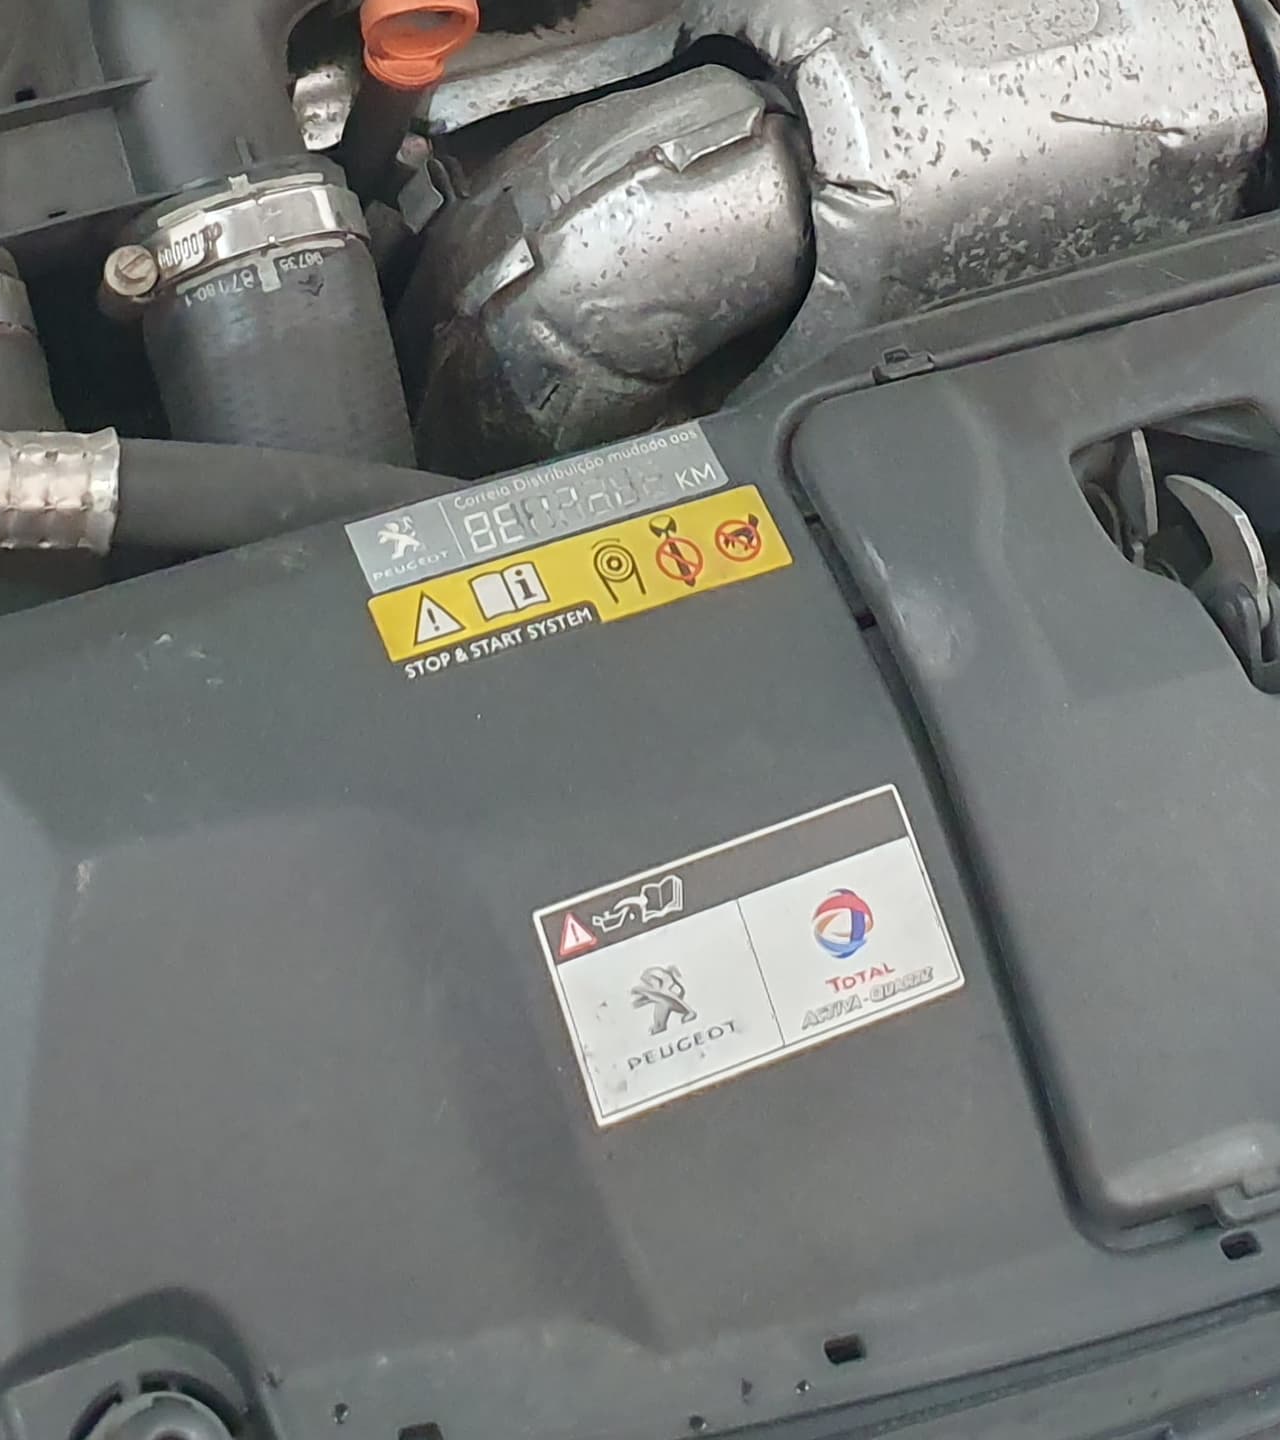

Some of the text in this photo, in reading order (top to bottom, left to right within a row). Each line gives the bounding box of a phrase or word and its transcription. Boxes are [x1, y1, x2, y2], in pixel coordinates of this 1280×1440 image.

[607, 437, 667, 466] mudada
[668, 429, 698, 445] aos
[674, 462, 717, 491] KM
[372, 549, 450, 582] PEUGEOT
[404, 606, 593, 679] STOP & START SYSTEM
[824, 962, 896, 993] TOTAL
[627, 1020, 737, 1071] PEUGEOT
